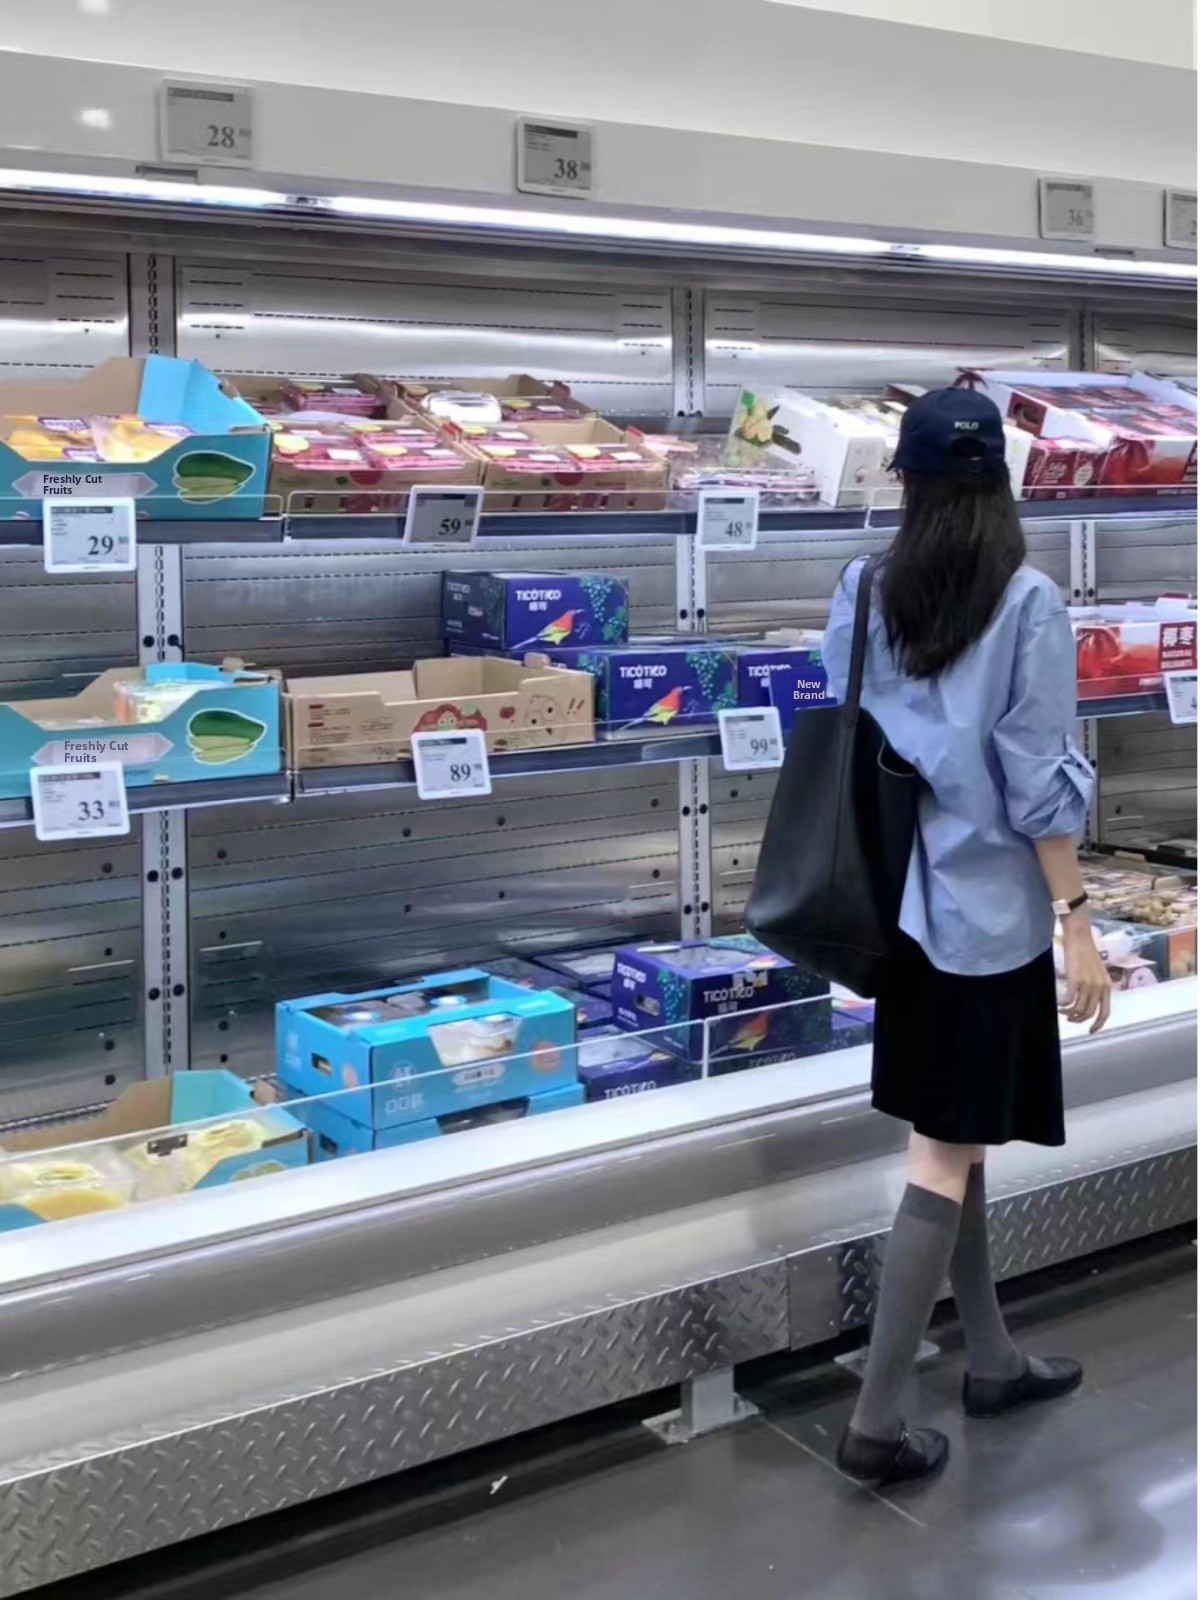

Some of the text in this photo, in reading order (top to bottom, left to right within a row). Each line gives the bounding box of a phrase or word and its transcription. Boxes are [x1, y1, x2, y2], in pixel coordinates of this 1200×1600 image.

[207, 125, 235, 149] 28
[554, 158, 578, 180] 38
[954, 421, 979, 430] POLO
[43, 474, 103, 485] Freshly Cut
[43, 485, 73, 495] Fruits
[439, 518, 461, 536] 59
[724, 520, 743, 538] 48
[87, 535, 114, 556] 29
[797, 679, 821, 689] New
[793, 690, 825, 700] Brand
[64, 740, 129, 753] Freshly Cut
[751, 738, 769, 755] 99
[64, 753, 97, 763] Fruits
[450, 762, 472, 782] 89
[78, 800, 104, 821] 33
